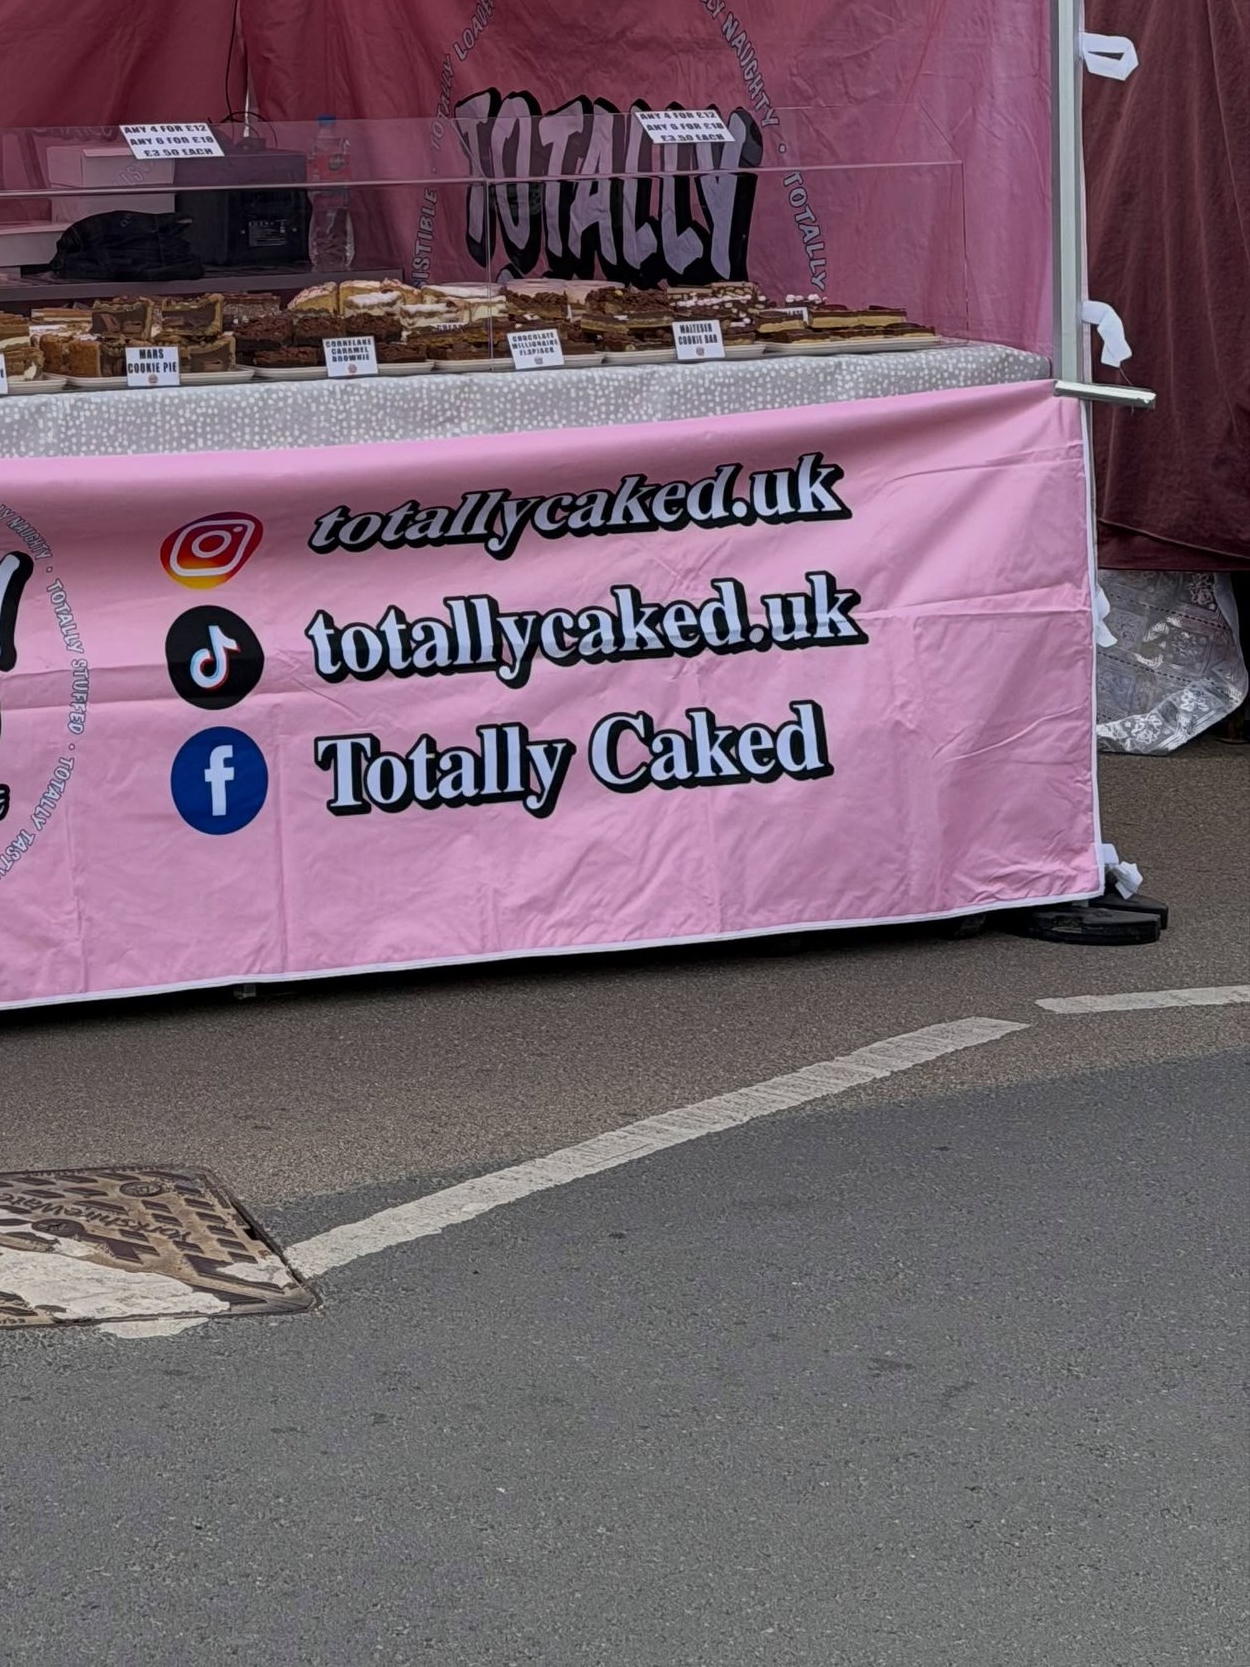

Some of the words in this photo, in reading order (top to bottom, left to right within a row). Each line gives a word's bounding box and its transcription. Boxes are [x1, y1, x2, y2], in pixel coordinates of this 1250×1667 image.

[721, 12, 780, 129] NAUGHTY
[454, 86, 763, 290] TOTALLY
[783, 170, 827, 291] TOTALLY
[128, 362, 160, 374] COOKIE
[163, 361, 177, 372] PIE
[139, 348, 164, 359] MARS
[331, 347, 369, 355] CARAMEL
[6, 515, 53, 561] NAUGHTY
[307, 451, 853, 561] totallycaked.uk
[46, 577, 85, 654] TOTALLY
[304, 570, 870, 690] totallycaked.uk
[65, 658, 90, 735] STUFFED
[34, 755, 76, 832] TOTALLY
[313, 720, 580, 819] Totally
[588, 698, 837, 796] Caked
